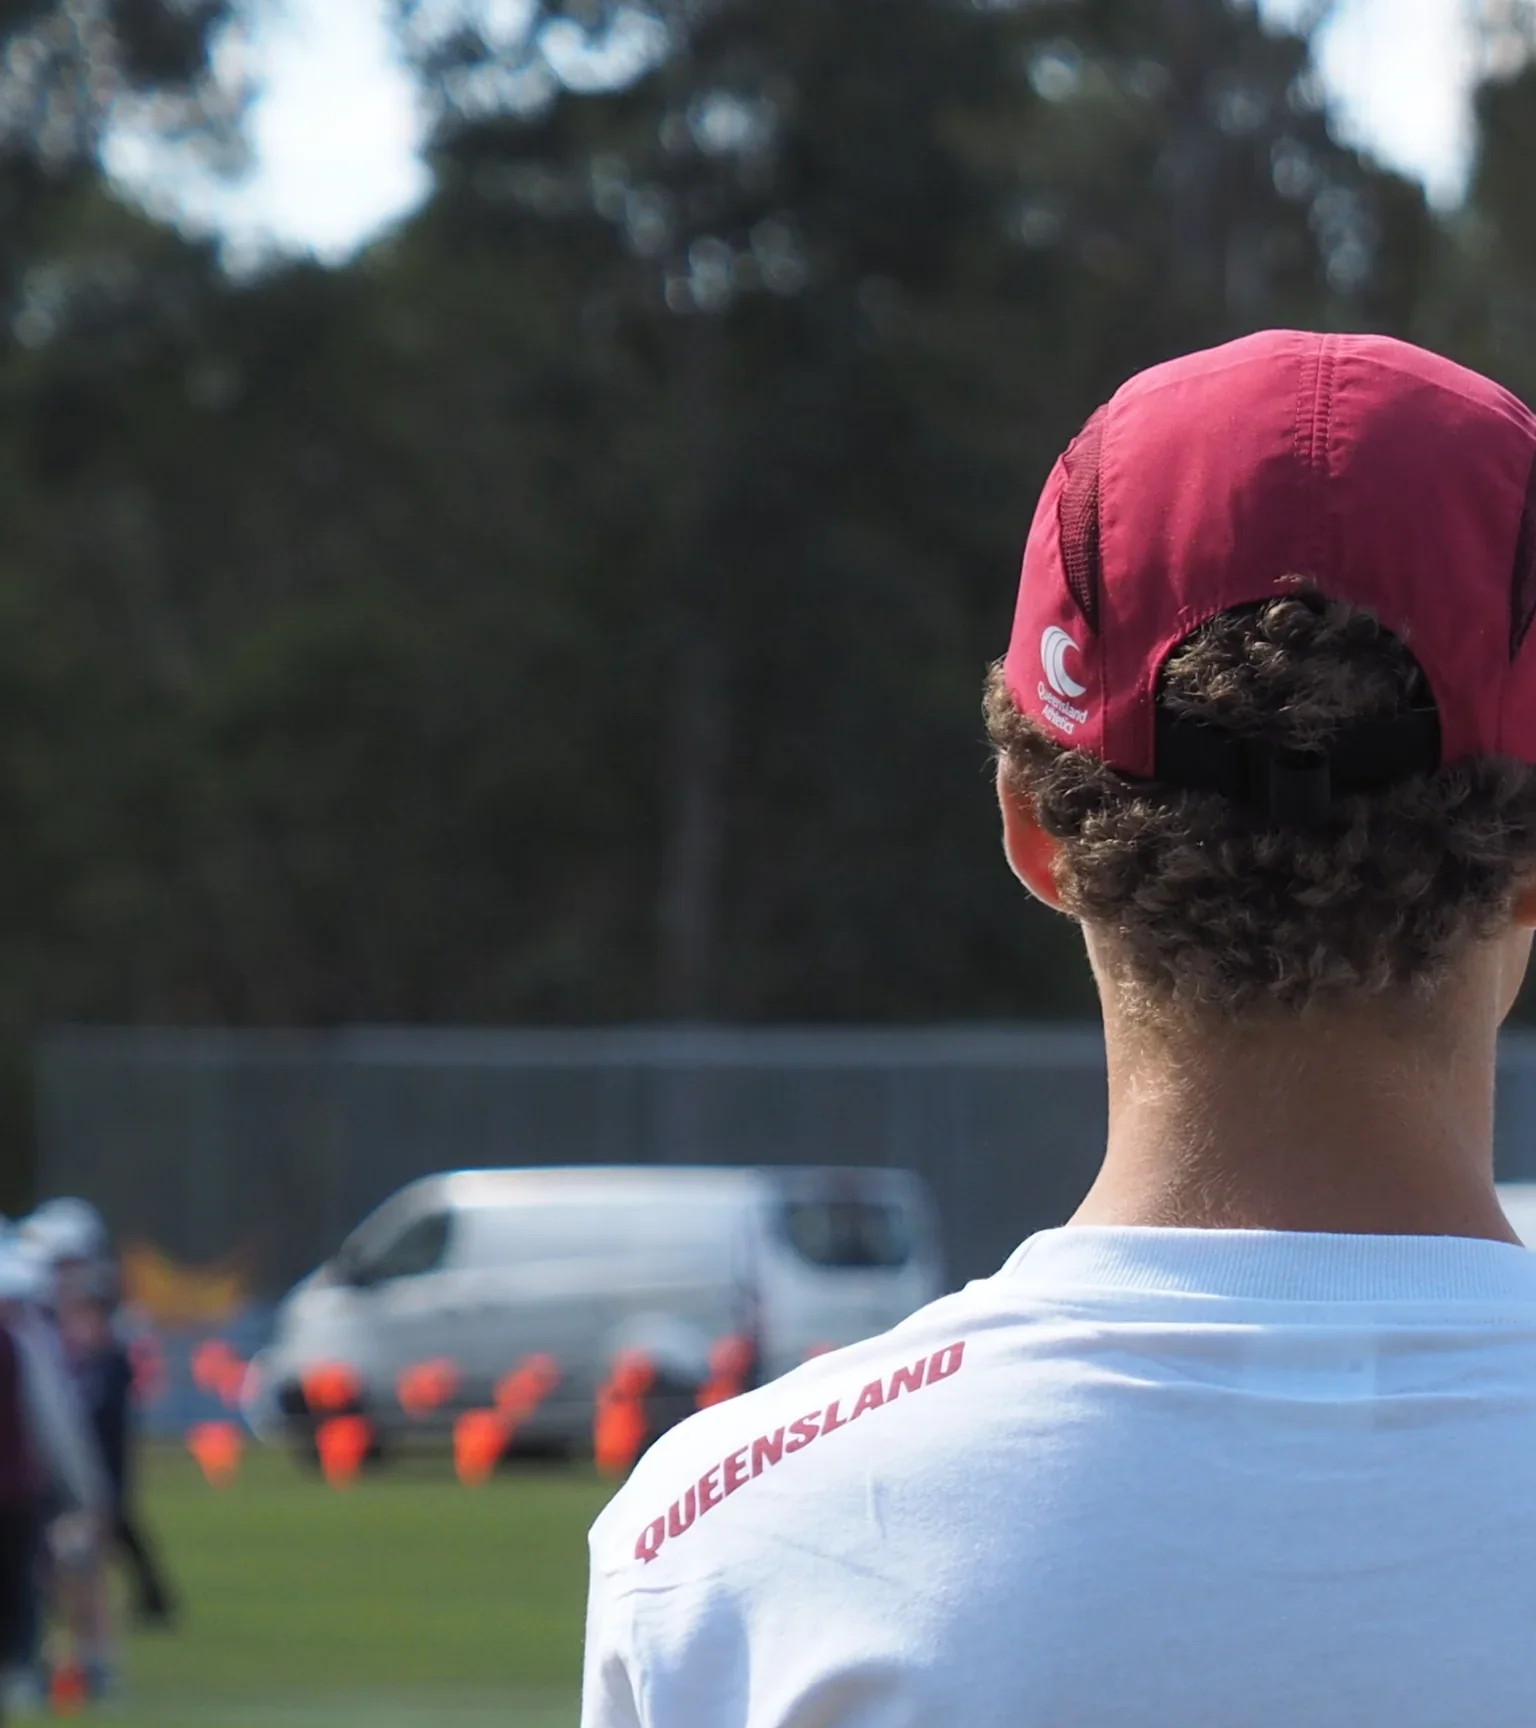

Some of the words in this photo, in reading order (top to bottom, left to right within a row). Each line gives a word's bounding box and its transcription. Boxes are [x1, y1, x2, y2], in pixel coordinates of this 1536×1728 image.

[1037, 680, 1088, 724] Queensland
[1042, 704, 1075, 735] Athletics
[634, 1340, 966, 1564] QUEENSLAND
